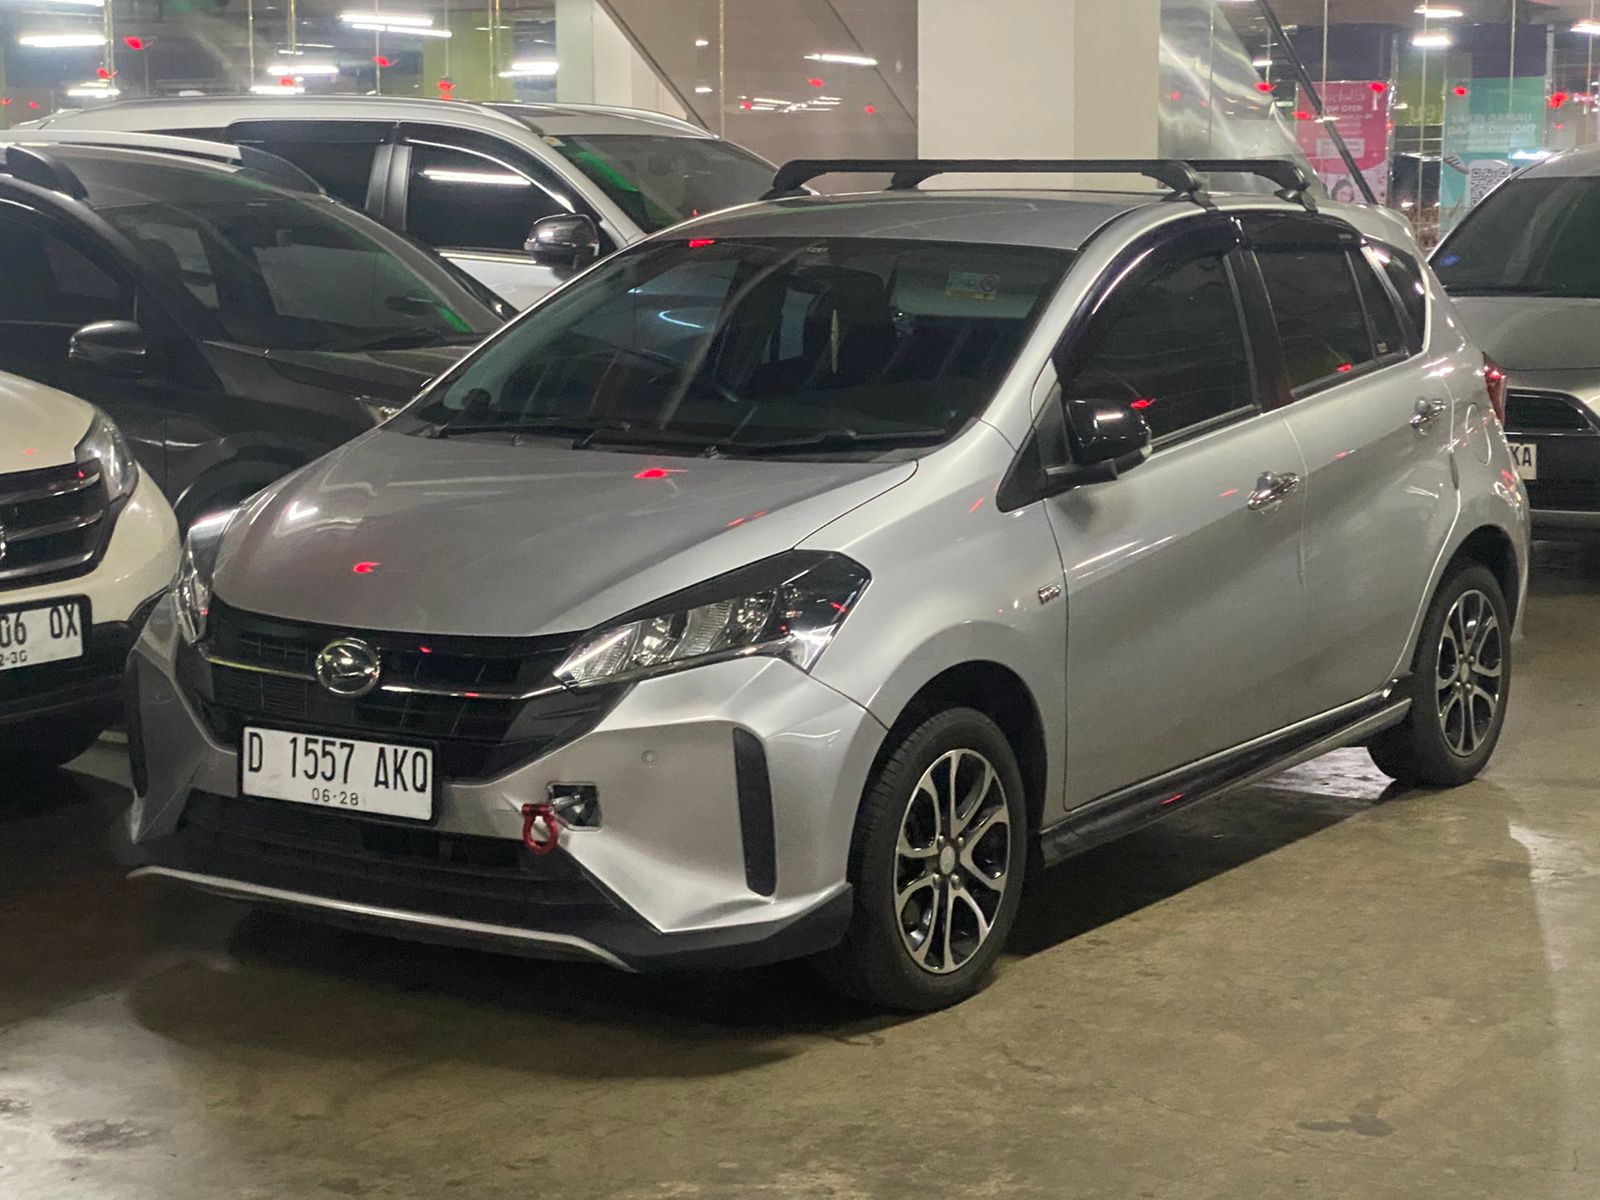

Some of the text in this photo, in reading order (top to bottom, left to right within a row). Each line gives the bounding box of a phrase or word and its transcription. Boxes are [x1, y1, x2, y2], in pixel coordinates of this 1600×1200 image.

[248, 732, 428, 793] D 1557 AKQ
